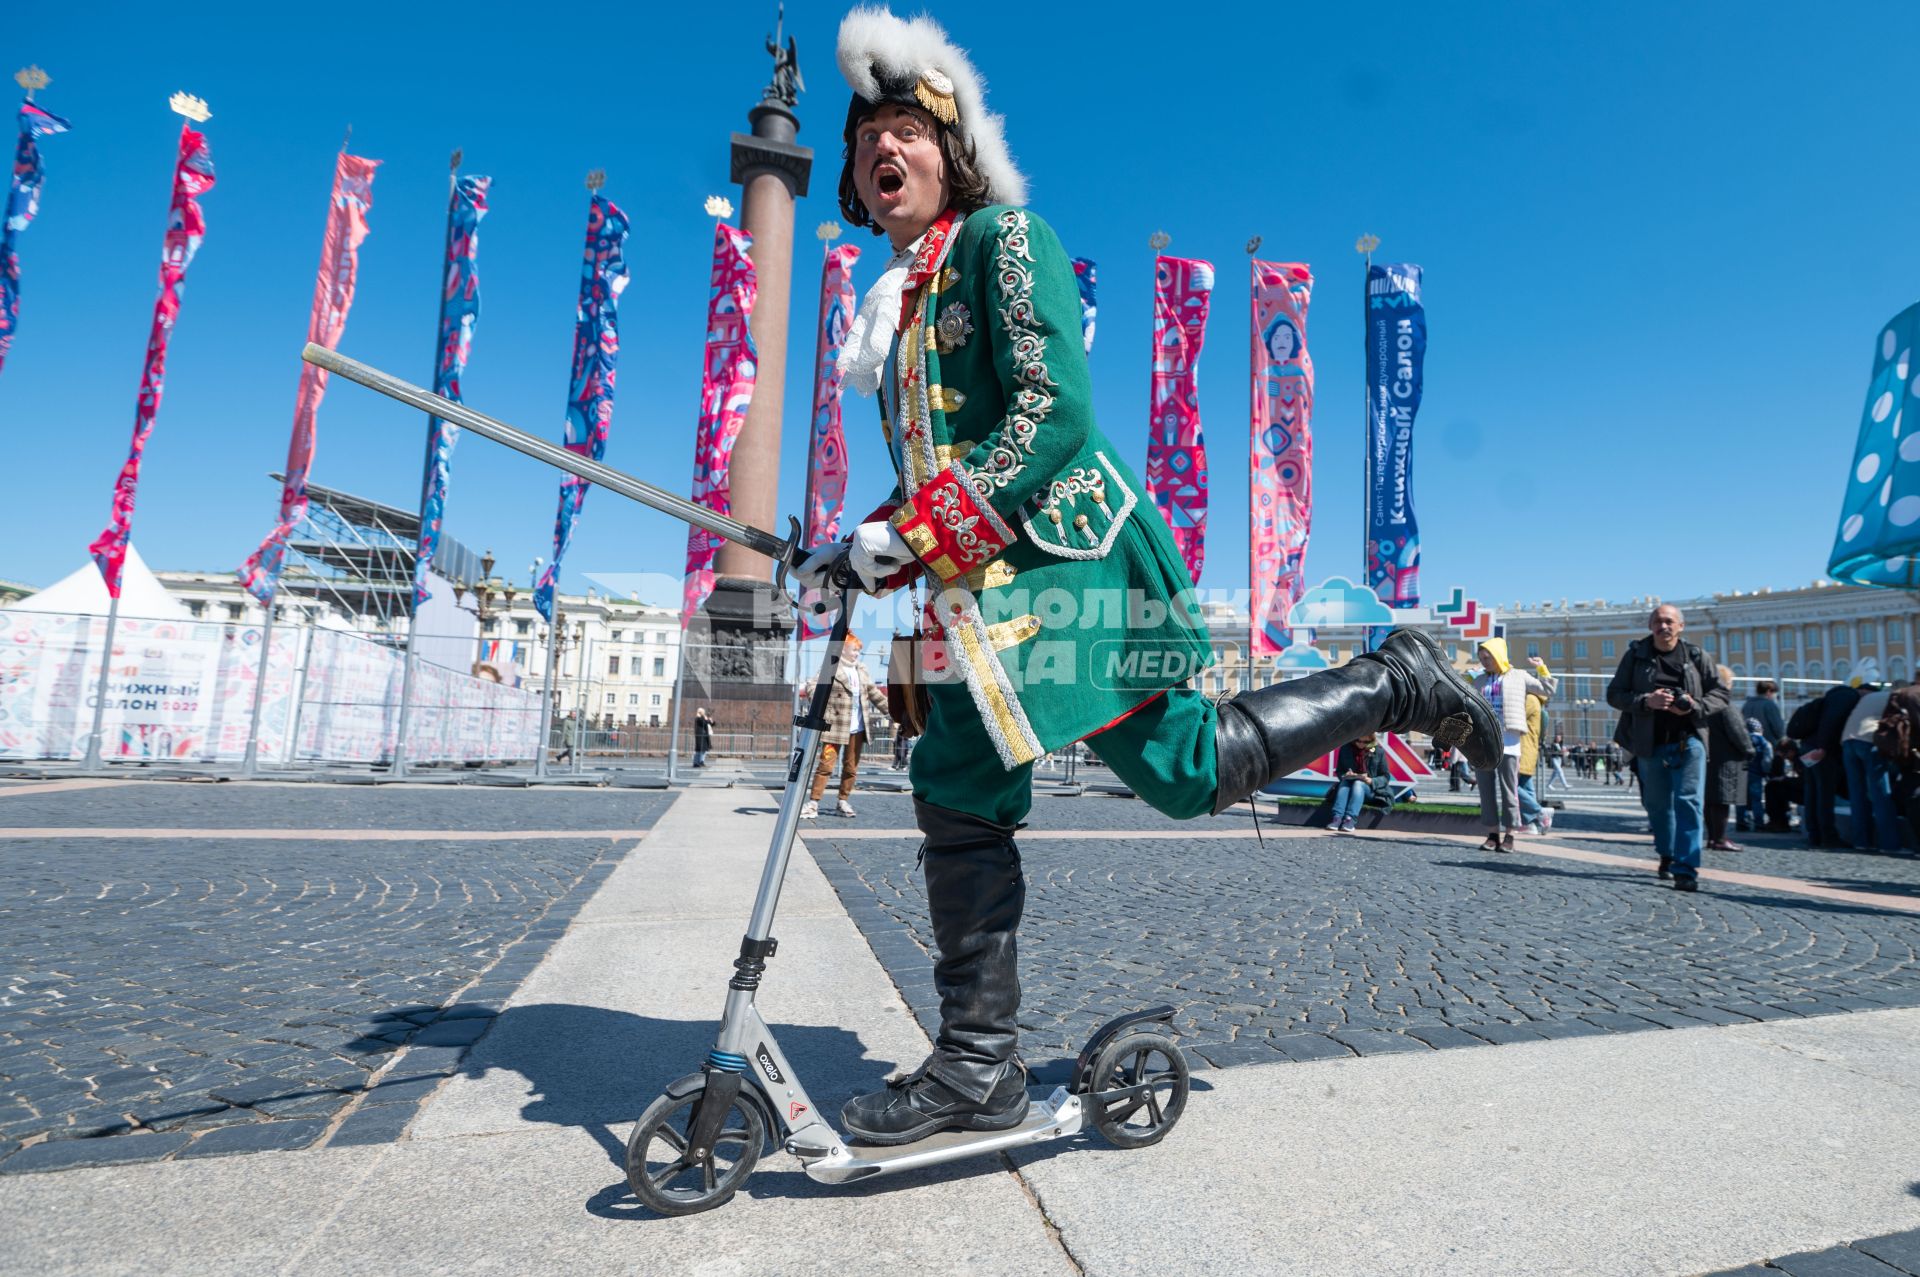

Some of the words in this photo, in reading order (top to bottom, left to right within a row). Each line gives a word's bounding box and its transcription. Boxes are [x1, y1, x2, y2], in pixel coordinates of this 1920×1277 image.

[1376, 320, 1389, 407] международный
[1393, 319, 1413, 398] Салон
[1375, 410, 1388, 526] Санкт-Петербургский
[1390, 405, 1412, 524] Книжный
[162, 701, 199, 712] 2022
[760, 1054, 778, 1081] oxelo
